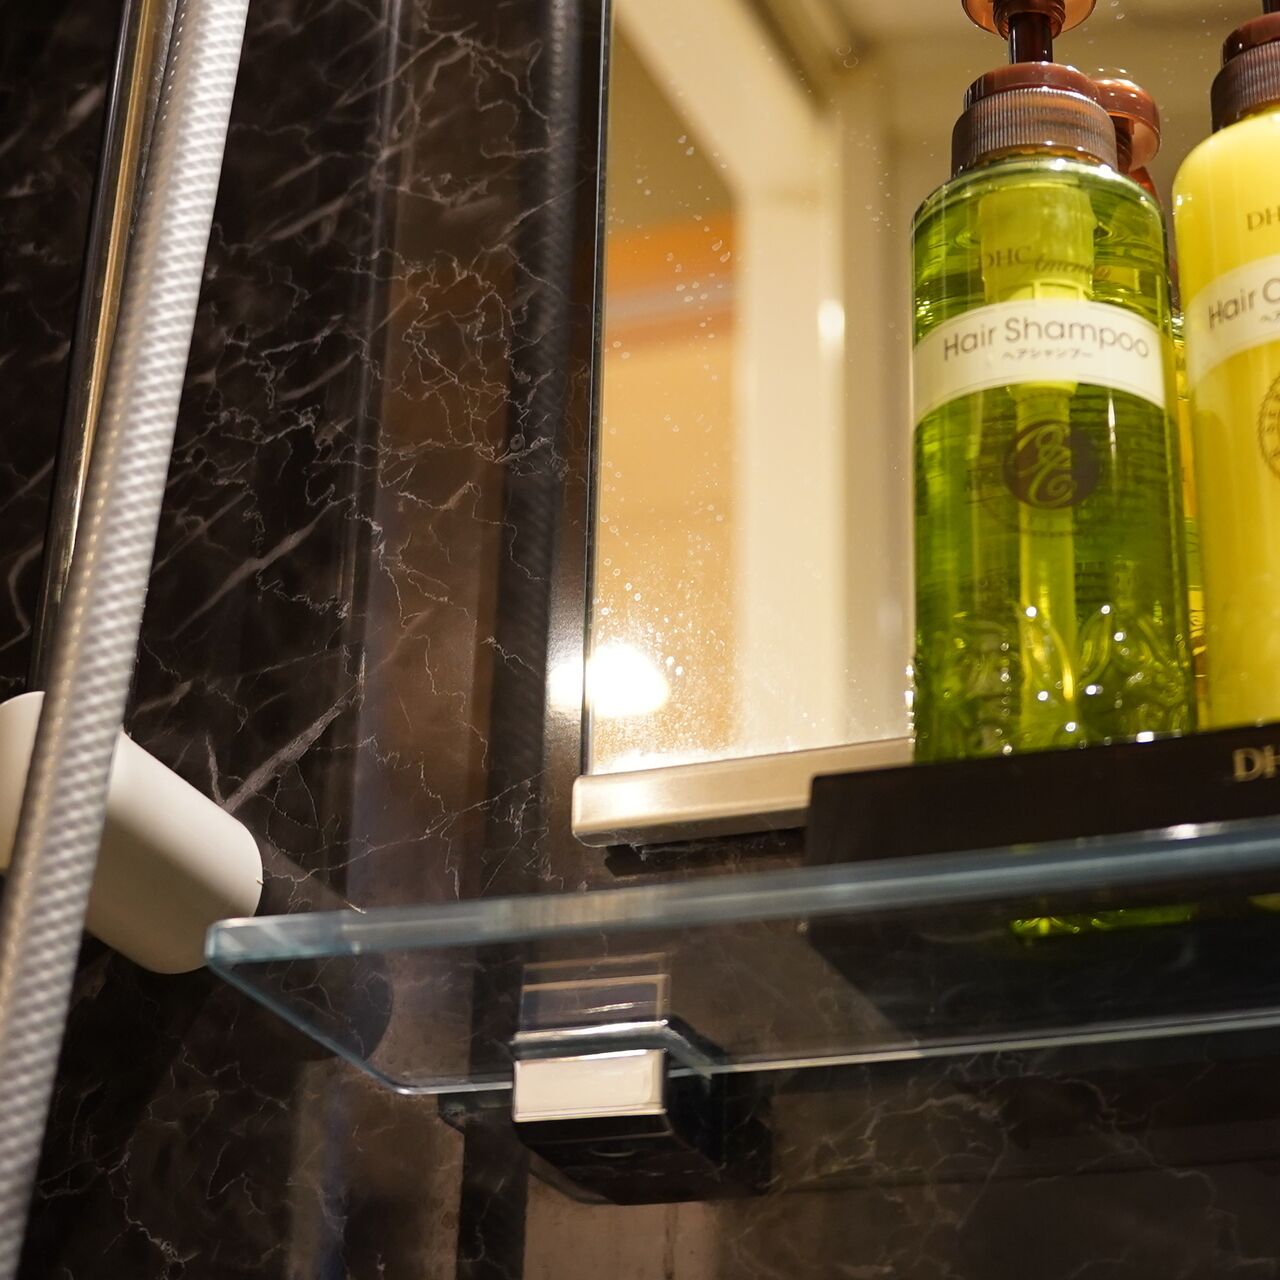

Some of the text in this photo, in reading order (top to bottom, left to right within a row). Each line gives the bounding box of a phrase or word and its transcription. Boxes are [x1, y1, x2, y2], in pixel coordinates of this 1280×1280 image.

[1208, 290, 1257, 330] Hair
[943, 317, 1149, 361] Hair Shampoo
